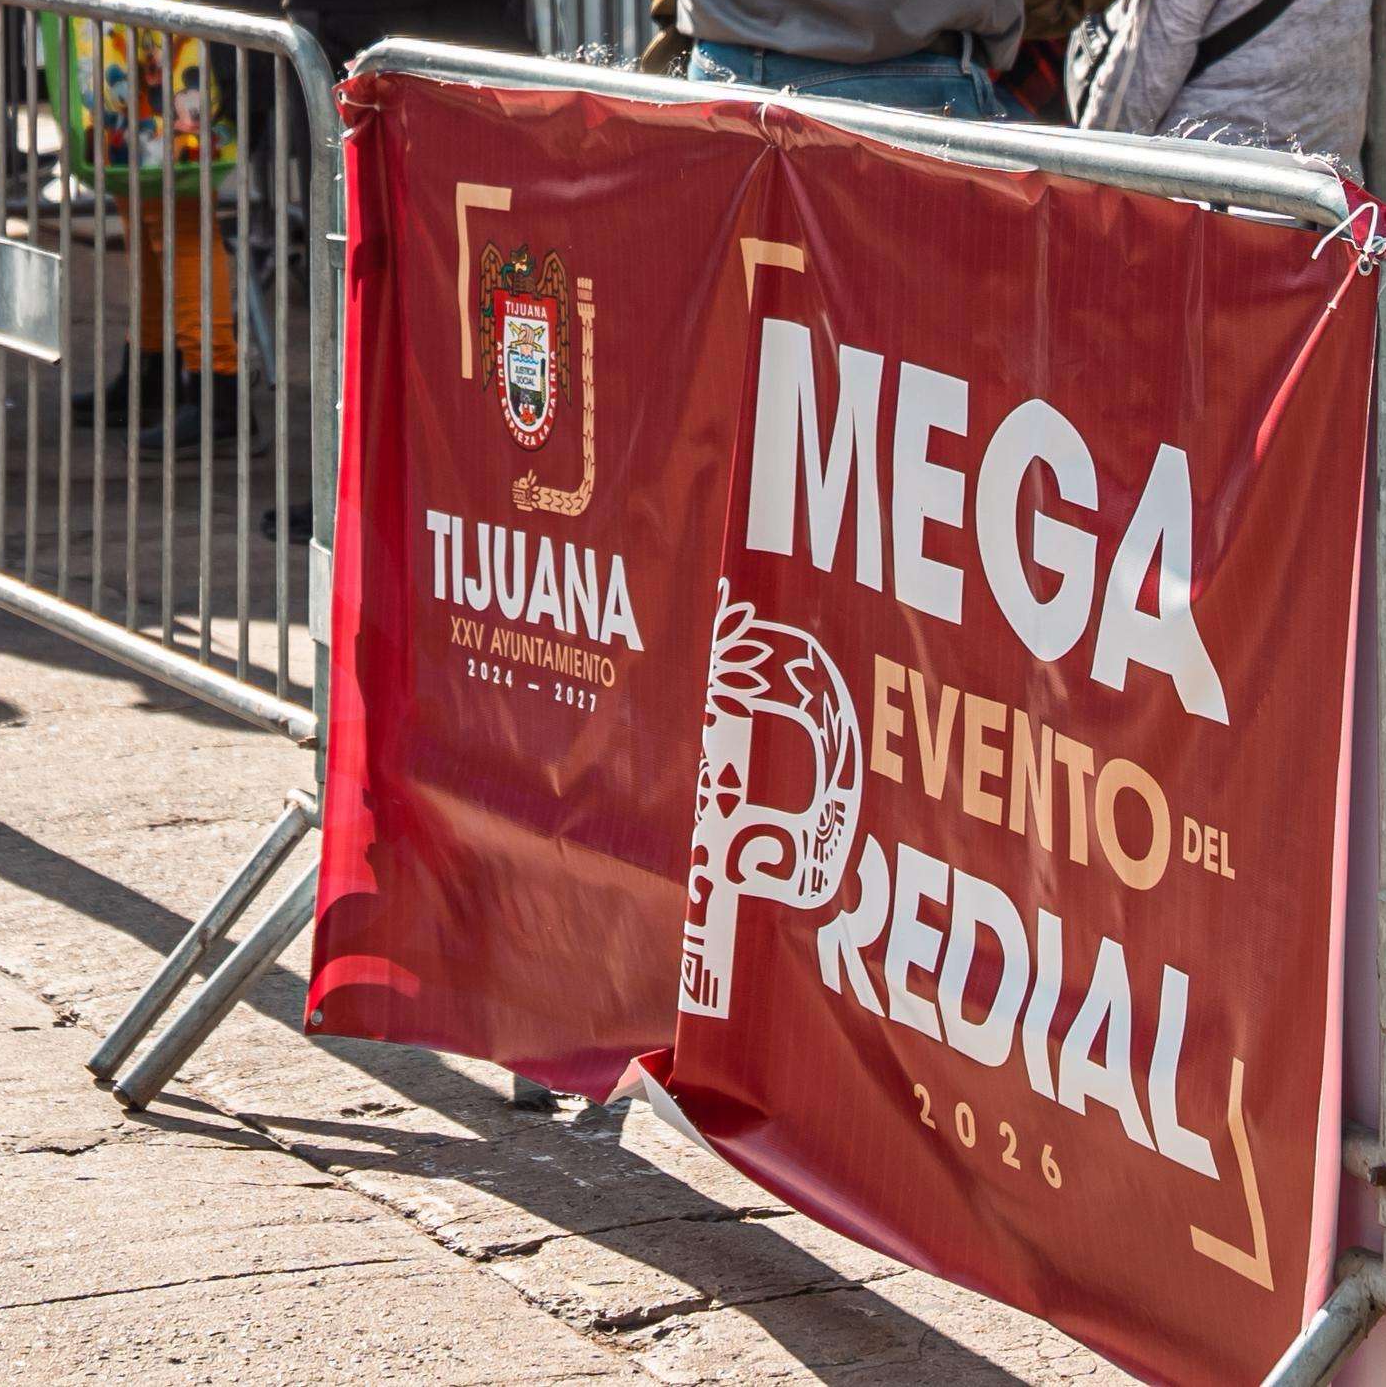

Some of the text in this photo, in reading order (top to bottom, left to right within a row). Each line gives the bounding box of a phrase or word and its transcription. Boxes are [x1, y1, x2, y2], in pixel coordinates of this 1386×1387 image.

[505, 300, 548, 319] TIJUANA
[501, 397, 537, 446] EMPIEZA
[538, 426, 551, 441] LA
[745, 317, 1230, 727] MEGA
[425, 509, 645, 653] TIJUANA
[450, 615, 616, 688] XXV AYUNTAMIENTO
[467, 658, 514, 689] 2024
[554, 682, 598, 713] 2027
[869, 653, 1236, 893] EVENTO DEL
[912, 1082, 1063, 1191] 2026
